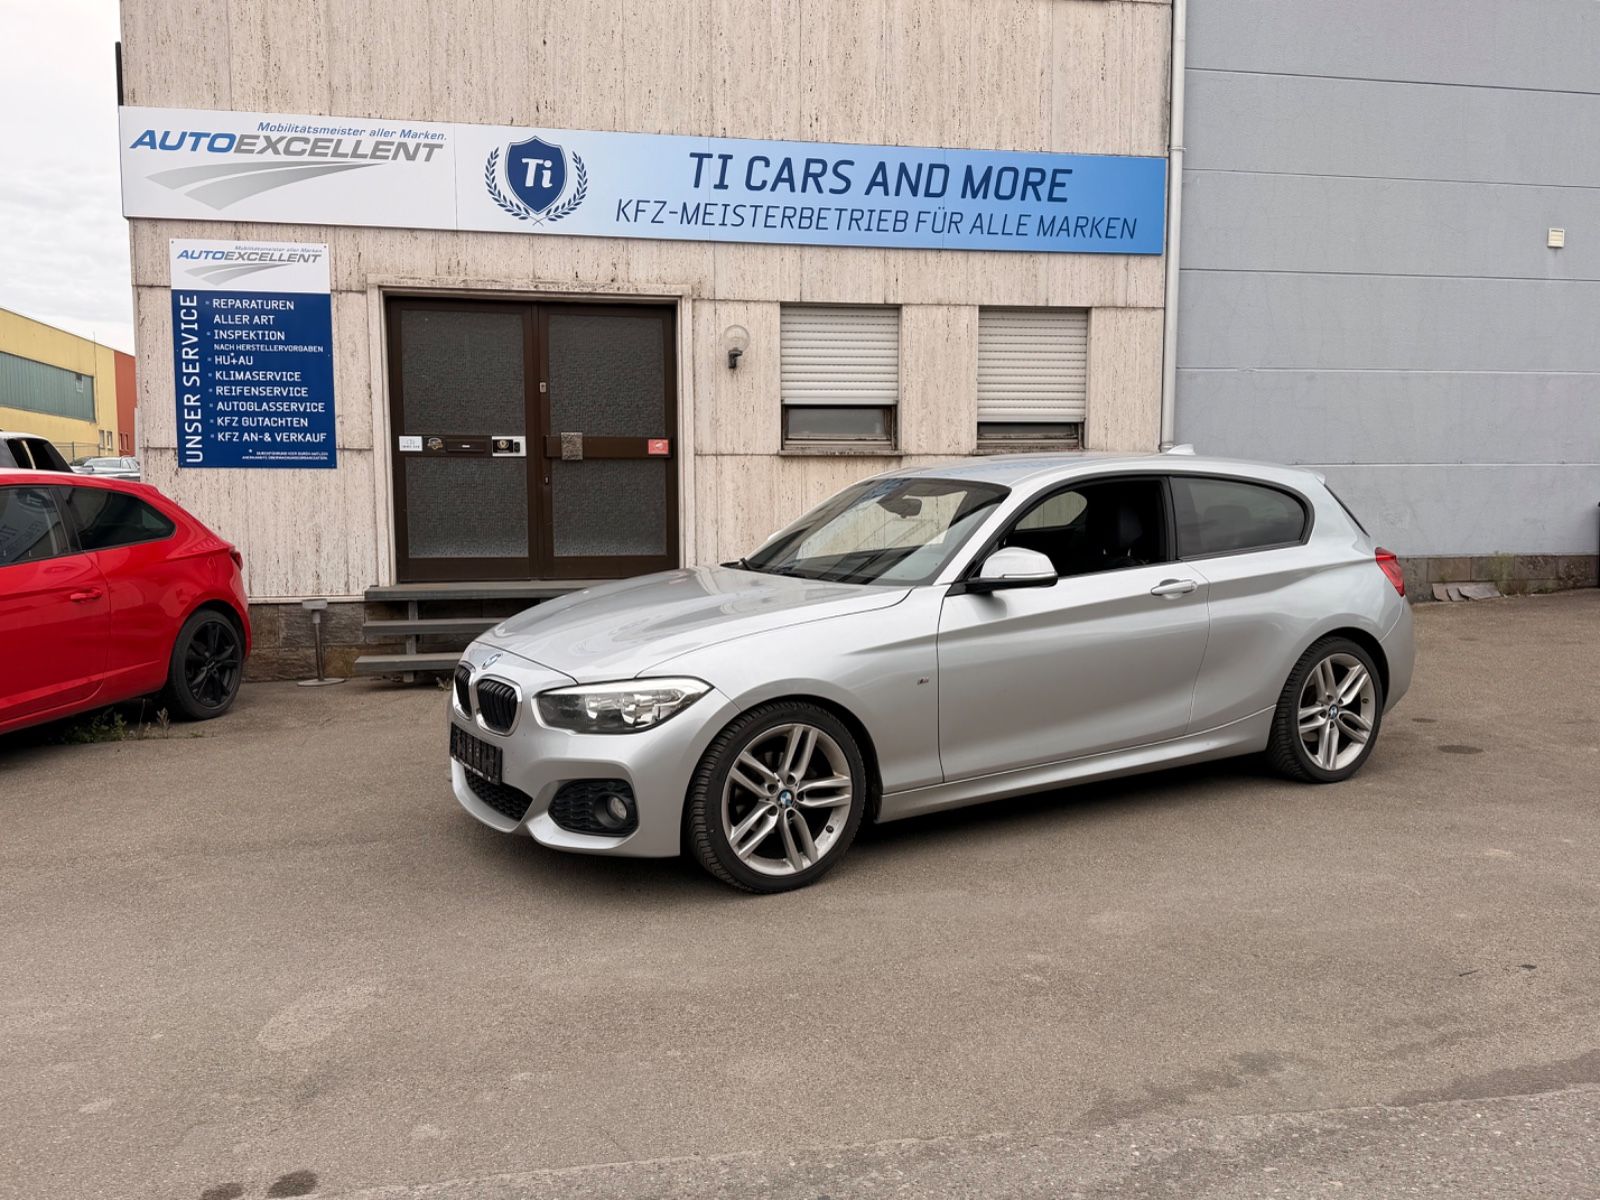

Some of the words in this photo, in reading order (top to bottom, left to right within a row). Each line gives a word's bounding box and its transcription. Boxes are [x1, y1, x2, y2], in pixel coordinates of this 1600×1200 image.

[369, 128, 397, 139] aller
[521, 157, 553, 188] Ti
[689, 152, 734, 190] TI
[744, 157, 854, 194] CARS
[864, 161, 950, 198] AND
[960, 164, 1073, 203] MORE
[616, 198, 909, 231] KFZ-MEISTERBETRIEB
[914, 206, 964, 235] FÜR
[969, 213, 1032, 237] ALLE
[1036, 215, 1138, 240] MARKEN
[212, 298, 295, 310] REPARATUREN
[213, 314, 250, 325] ALLER
[252, 315, 275, 325] ART
[180, 295, 199, 386] SERVICE
[213, 329, 286, 341] INSPEKTION
[214, 343, 235, 351] NACH
[235, 344, 324, 353] HERSTELLERVORGABEN
[215, 370, 302, 382] KLIMASERVICE
[215, 385, 309, 397] REIFENSERVICE
[216, 400, 326, 413] AUTOGLASSERVICE
[216, 416, 239, 427] KFZ
[241, 416, 309, 428] GUTACHTEN
[184, 394, 203, 463] UNSER
[217, 431, 240, 443] KFZ
[274, 432, 327, 443] VERKAUF
